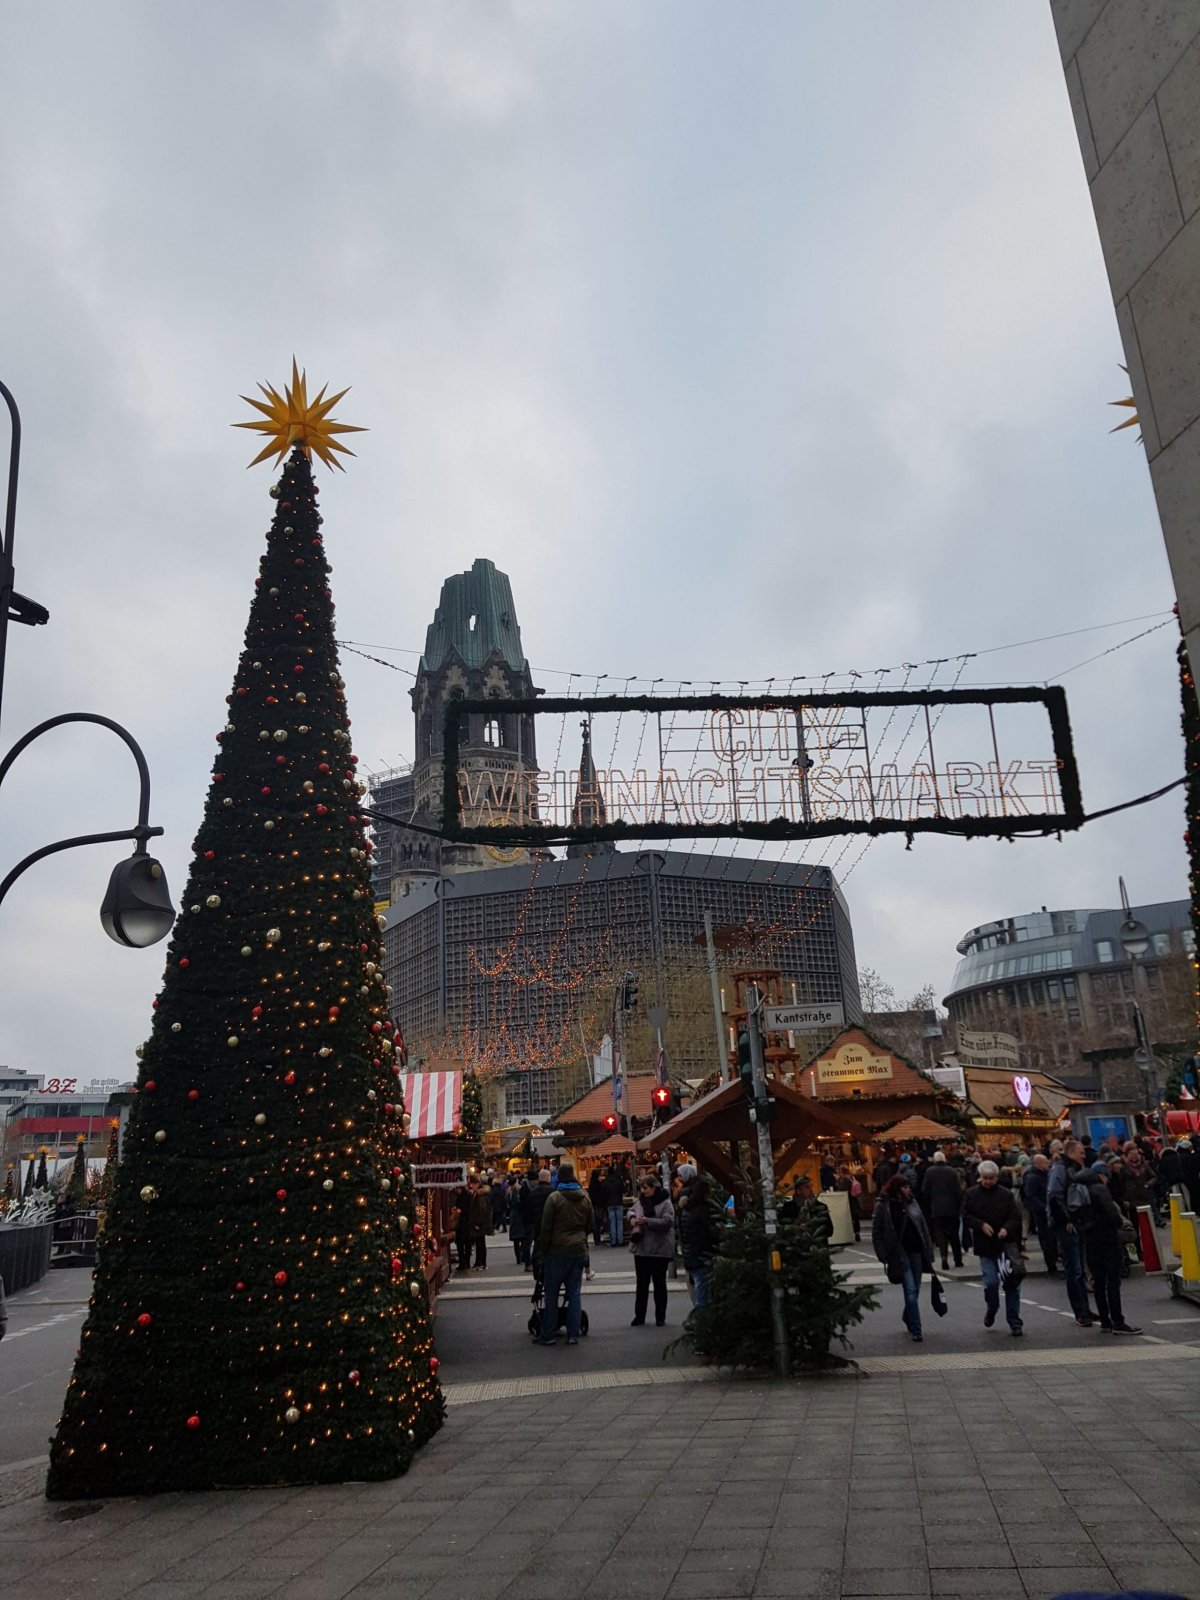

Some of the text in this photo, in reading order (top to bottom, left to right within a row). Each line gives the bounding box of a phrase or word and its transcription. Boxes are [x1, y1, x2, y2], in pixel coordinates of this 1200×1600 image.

[457, 759, 1064, 827] WEIHNACHTSMARKT
[775, 1010, 832, 1024] Kantstraße
[843, 1054, 863, 1066] Zum
[822, 1065, 889, 1078] strammen Max
